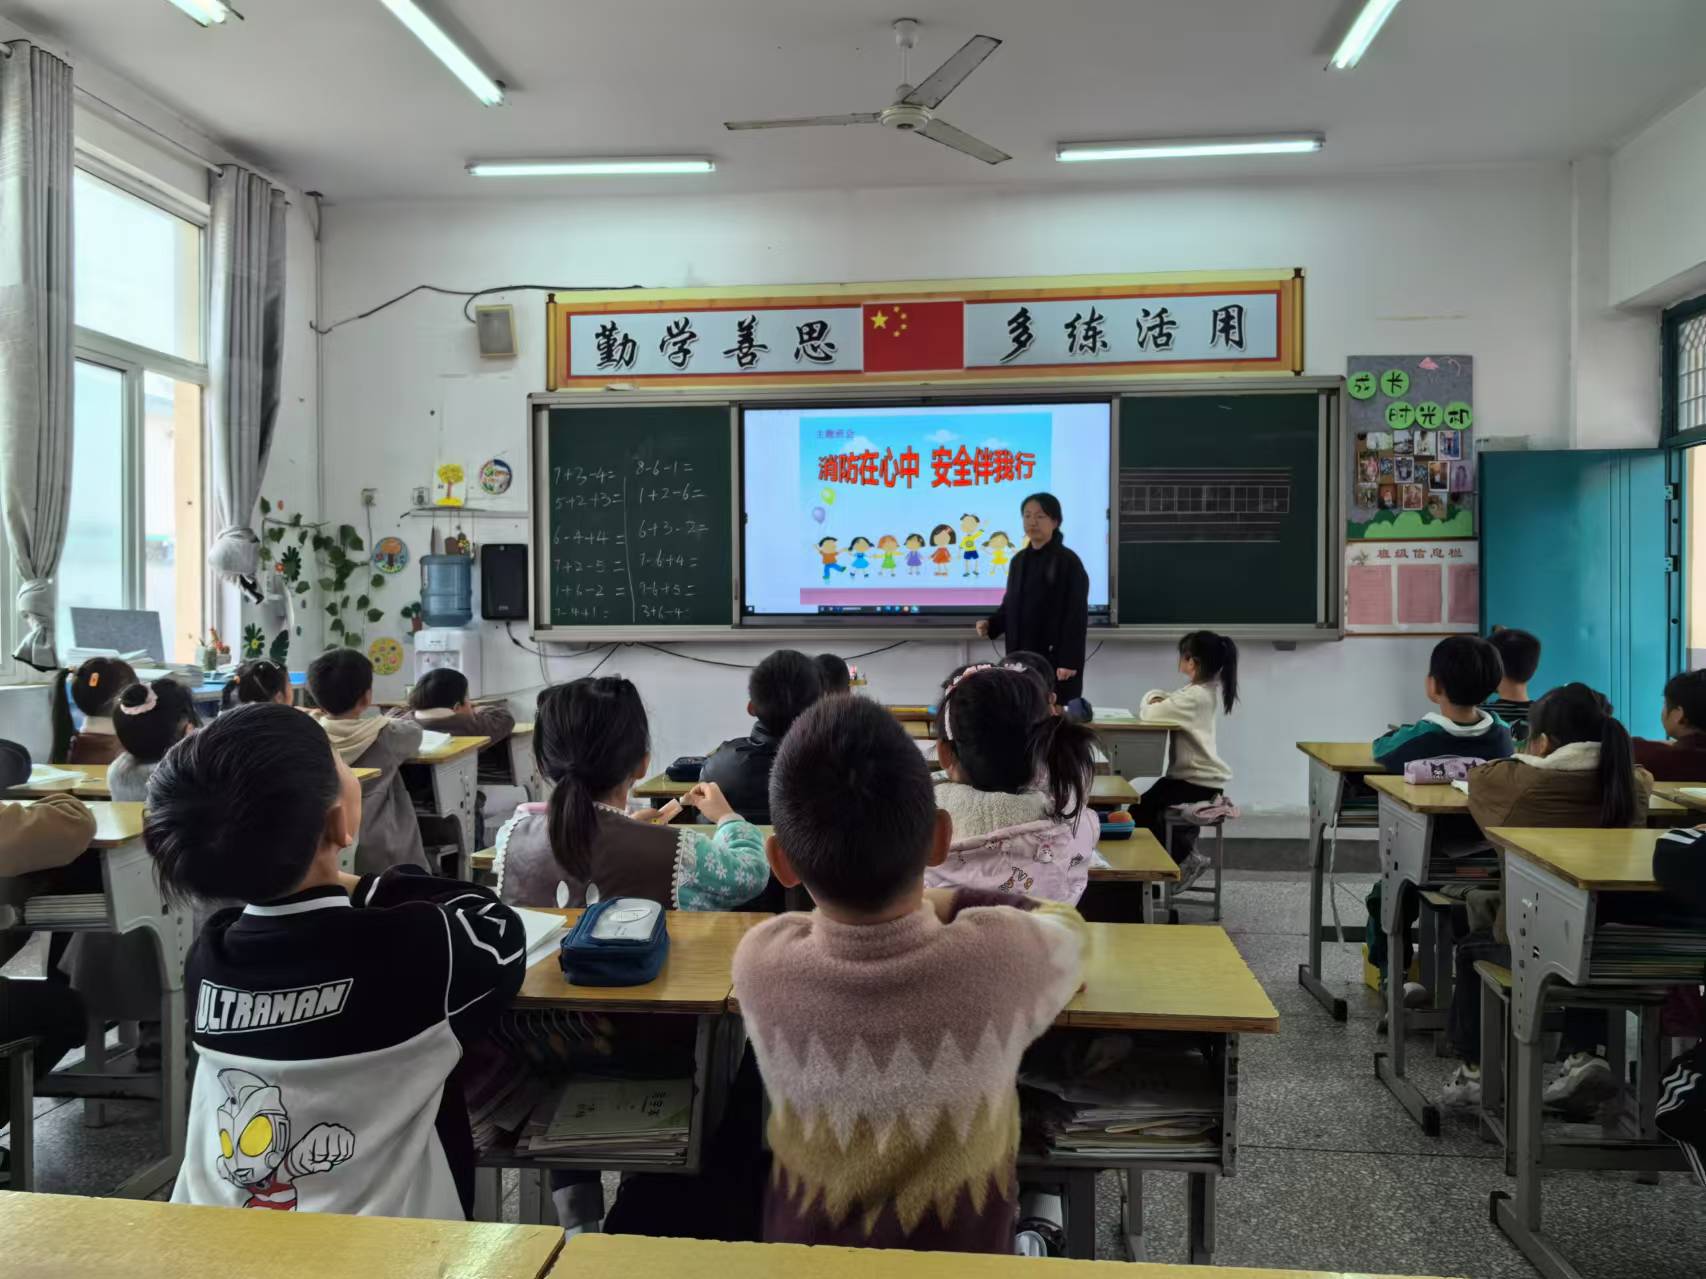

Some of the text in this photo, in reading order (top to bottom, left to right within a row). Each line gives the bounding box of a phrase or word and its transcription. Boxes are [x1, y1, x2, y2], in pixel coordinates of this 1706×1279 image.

[594, 303, 1245, 369] 勤学善思 多练活用
[817, 444, 1037, 489] 消防在心中 安全伴我行
[1376, 547, 1465, 560] 班级信息栏
[196, 982, 348, 1031] ULTRAMAN
